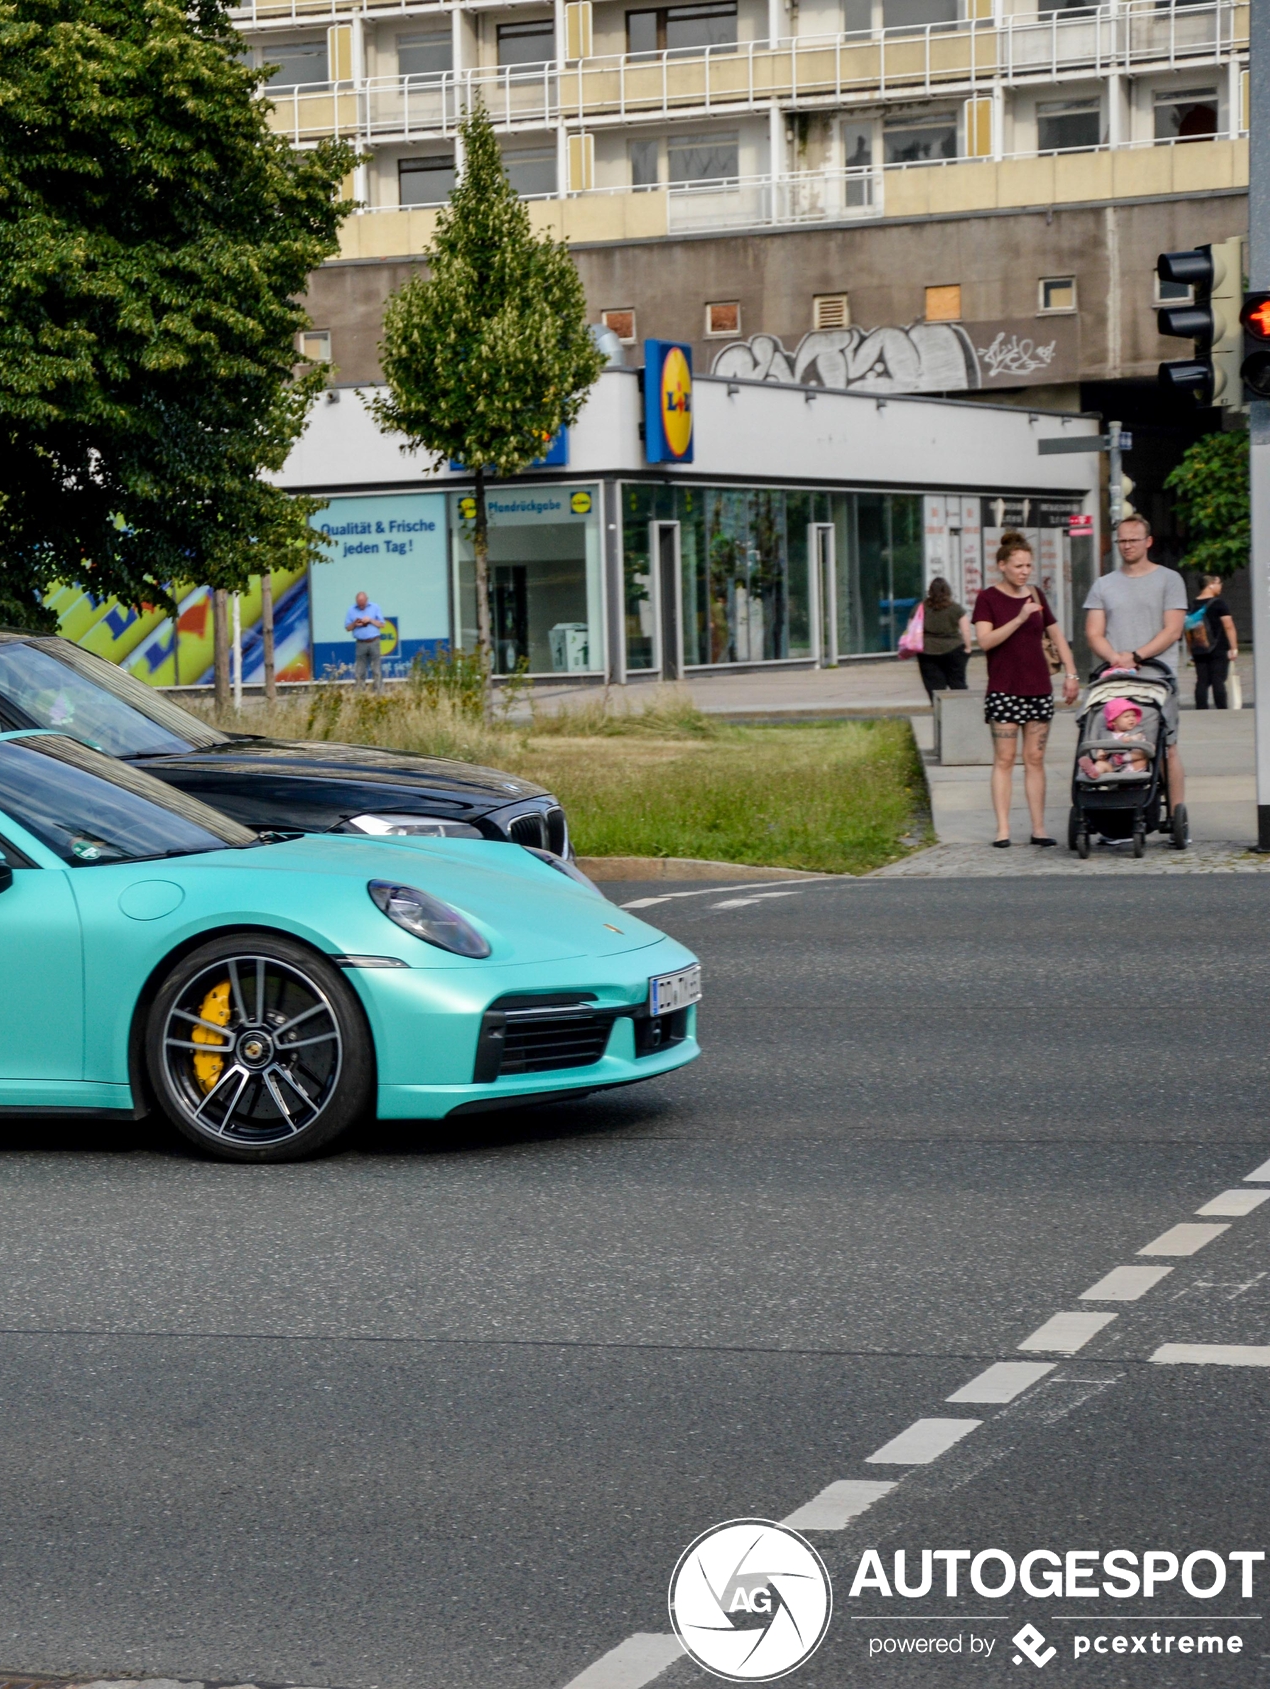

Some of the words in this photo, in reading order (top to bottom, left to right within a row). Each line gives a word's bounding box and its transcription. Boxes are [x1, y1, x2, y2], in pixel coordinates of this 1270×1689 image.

[488, 500, 561, 513] Pfandrückgabe
[321, 522, 372, 536] Qualität
[375, 521, 385, 533] &
[389, 519, 435, 533] Frische
[343, 541, 379, 557] jeden
[384, 539, 413, 555] Tag!
